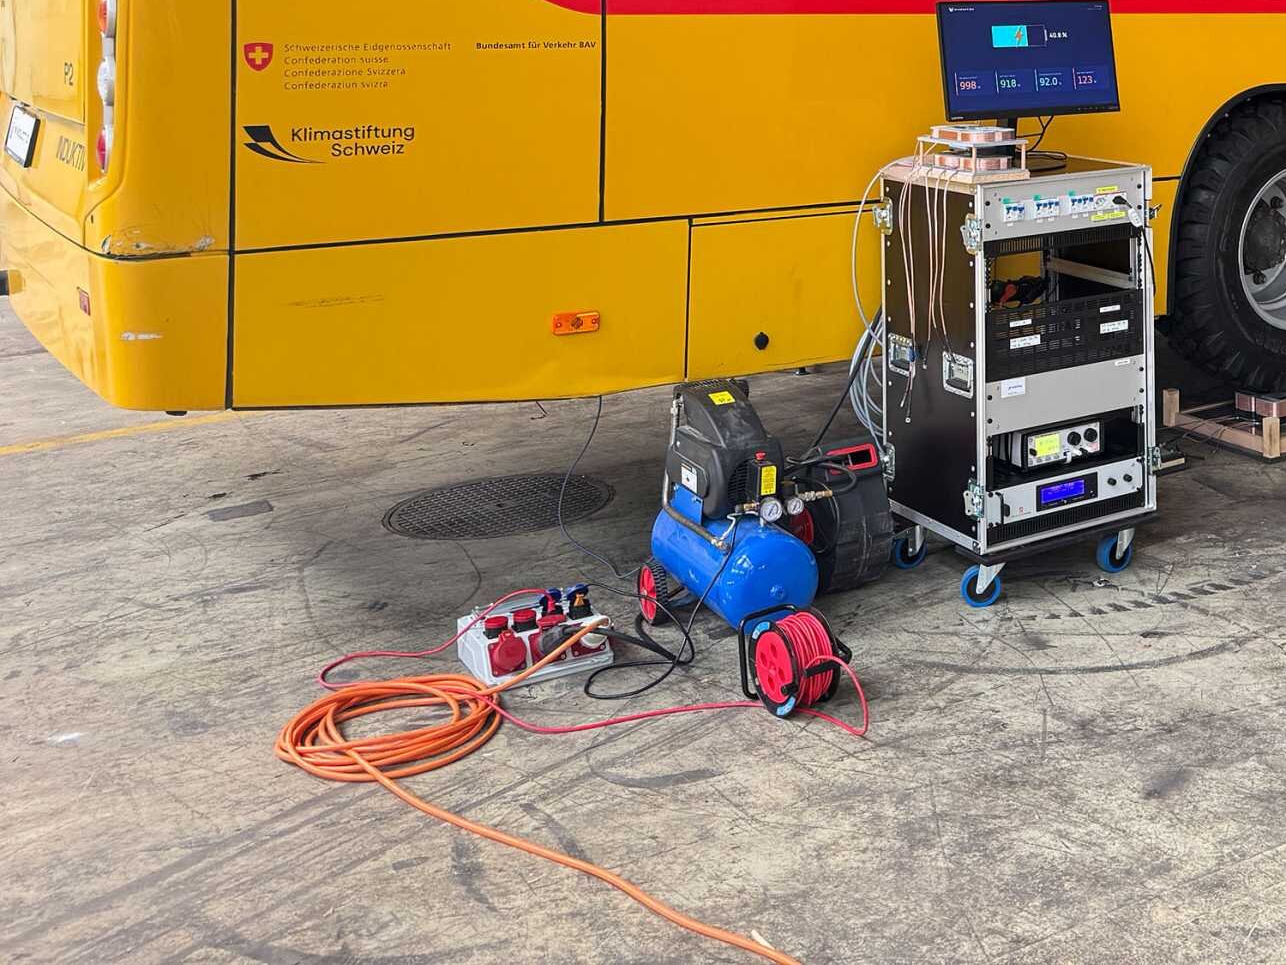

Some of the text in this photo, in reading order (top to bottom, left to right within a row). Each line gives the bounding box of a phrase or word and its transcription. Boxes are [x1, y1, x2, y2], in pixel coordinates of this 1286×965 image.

[284, 42, 452, 53] Schweizerische Eidgenossenschaft
[476, 40, 597, 50] Bundesamt für Verkehr BAV
[360, 56, 389, 64] suisse
[284, 67, 406, 78] Confederazione Svizzera
[284, 81, 358, 91] Confederaziun
[1000, 79, 1017, 88] 918
[1039, 77, 1058, 86] 92.0
[1077, 75, 1093, 84] 123
[291, 124, 415, 142] Klimastiftung
[331, 141, 405, 157] Schweiz
